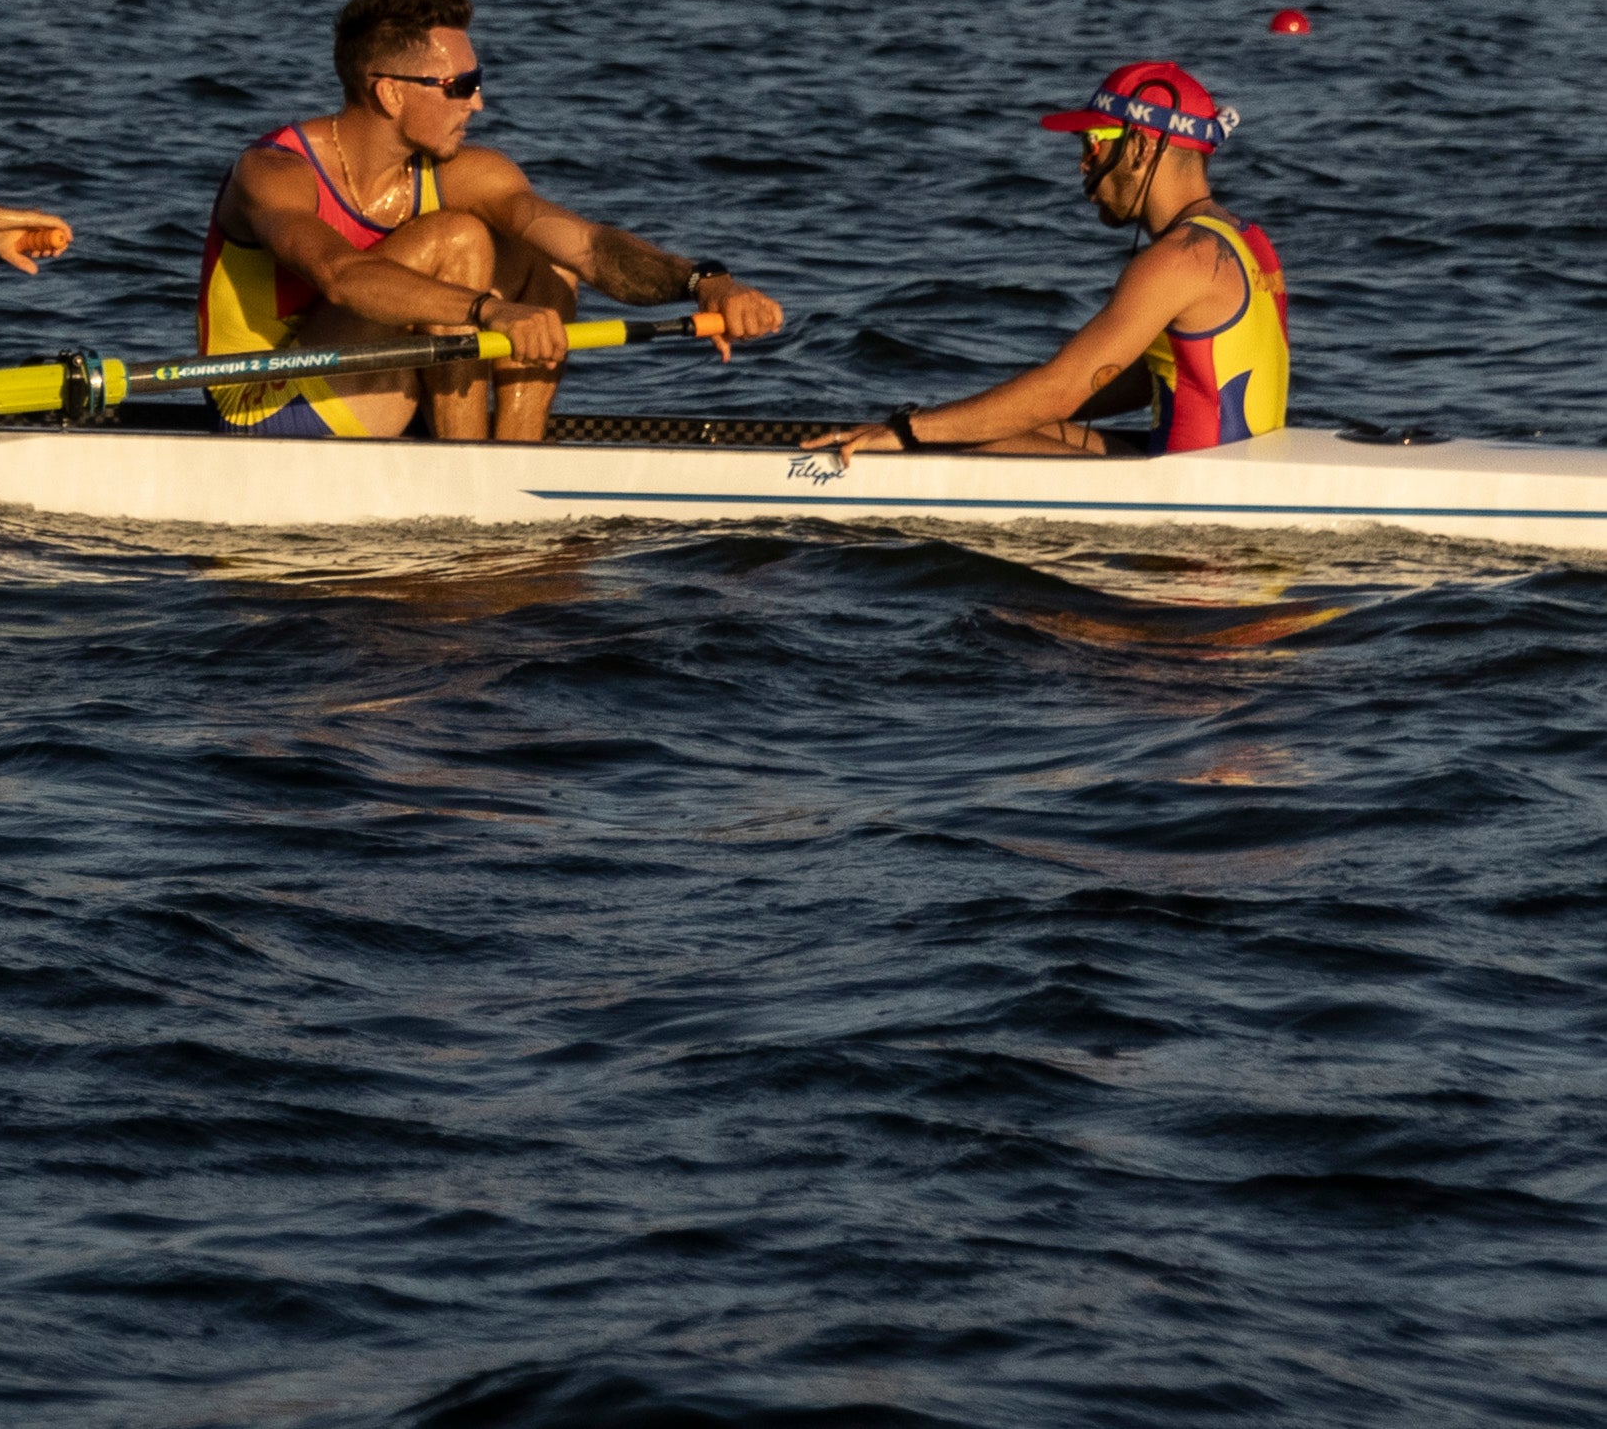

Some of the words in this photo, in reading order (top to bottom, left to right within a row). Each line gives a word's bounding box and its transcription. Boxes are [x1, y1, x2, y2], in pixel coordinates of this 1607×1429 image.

[1093, 93, 1115, 111] NK
[1126, 102, 1154, 123] NK
[1167, 113, 1196, 135] NK
[180, 362, 246, 377] concept
[250, 359, 261, 371] 2
[268, 353, 334, 370] SKINNY
